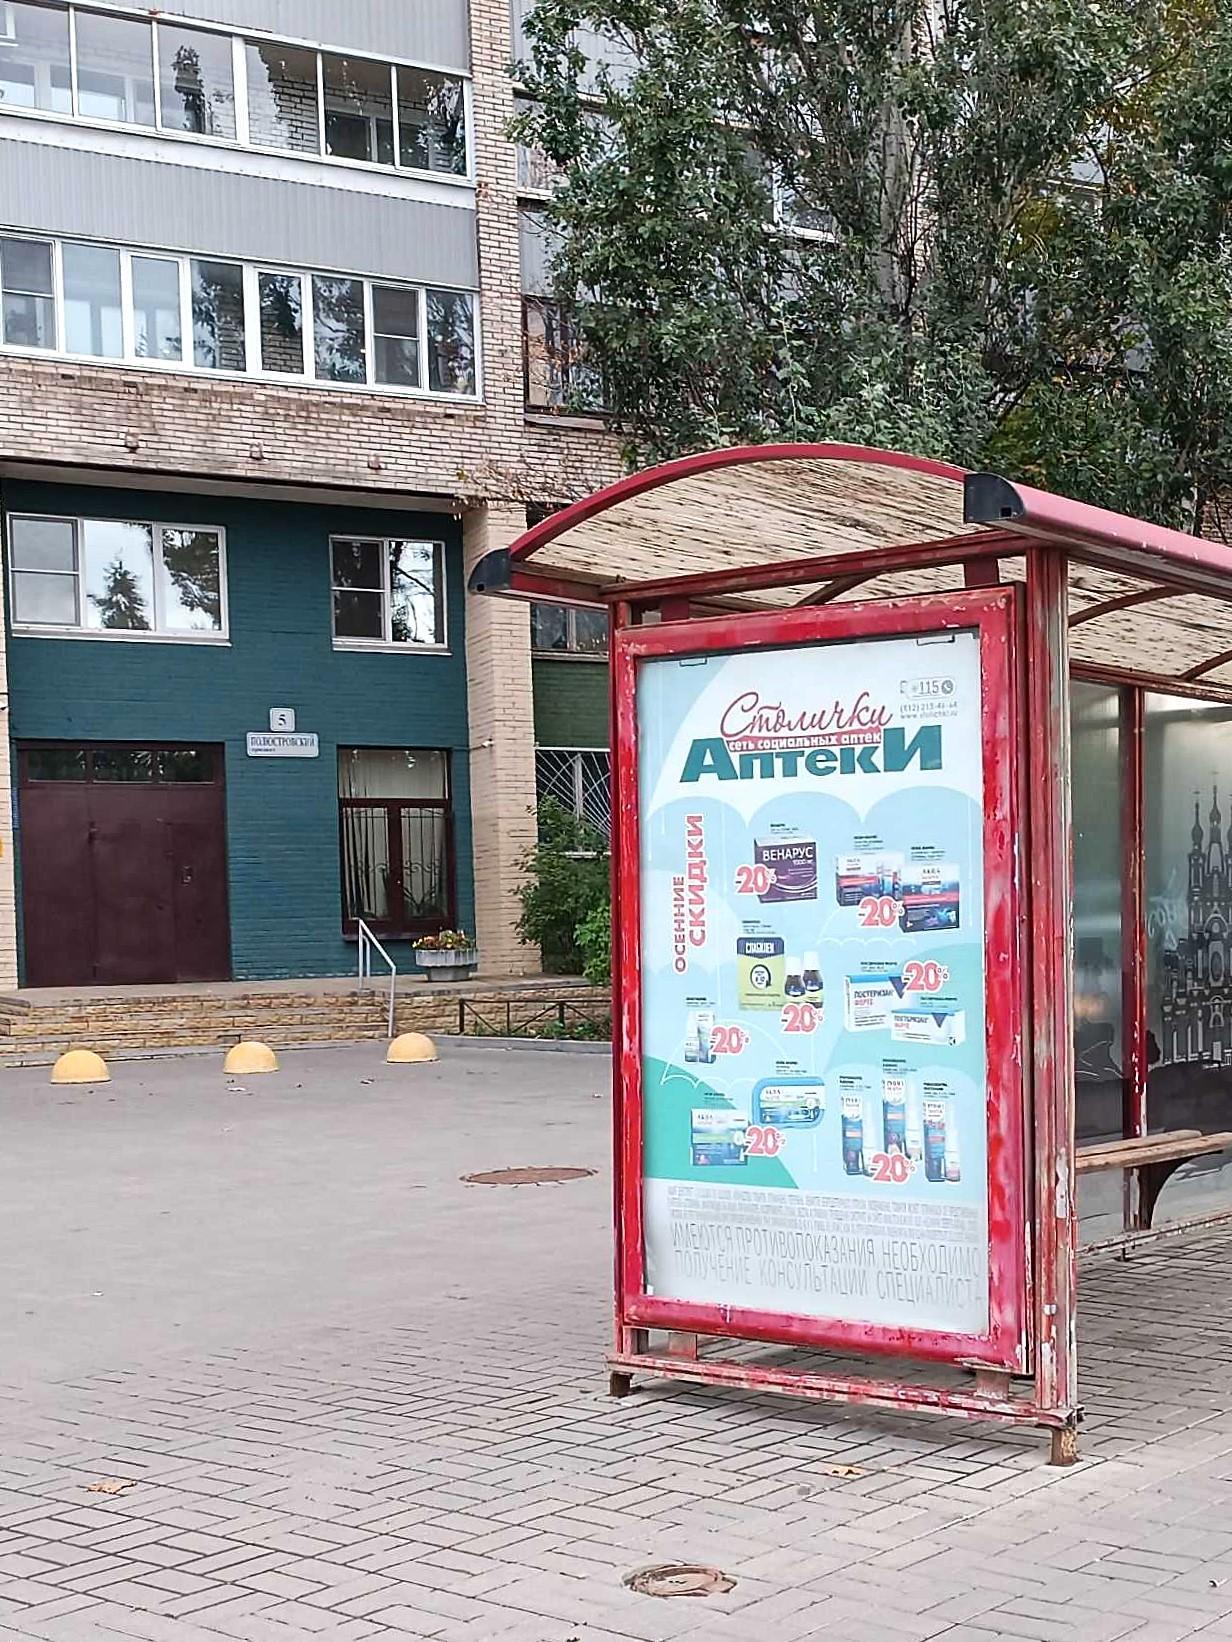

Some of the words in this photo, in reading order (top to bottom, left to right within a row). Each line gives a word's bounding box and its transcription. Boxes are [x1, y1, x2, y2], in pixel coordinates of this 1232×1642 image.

[278, 713, 287, 726] 5
[720, 691, 894, 738] Столички
[728, 740, 755, 752] сеть
[757, 734, 839, 750] социальных
[840, 732, 882, 746] аптек
[762, 846, 814, 861] ВЕНАРУС
[686, 815, 707, 946] СКИДКИ
[735, 866, 778, 893] -20%
[673, 876, 687, 973] ОСЕННИЕ
[858, 898, 904, 927] -20%
[903, 962, 949, 992] -20%
[781, 1004, 824, 1032] -20%
[869, 1154, 916, 1182] -20%
[735, 1225, 875, 1268] ПРОТИВОПОКАЗАНИЯ
[760, 1258, 869, 1297] КОНСУЛЬТАЦИИ
